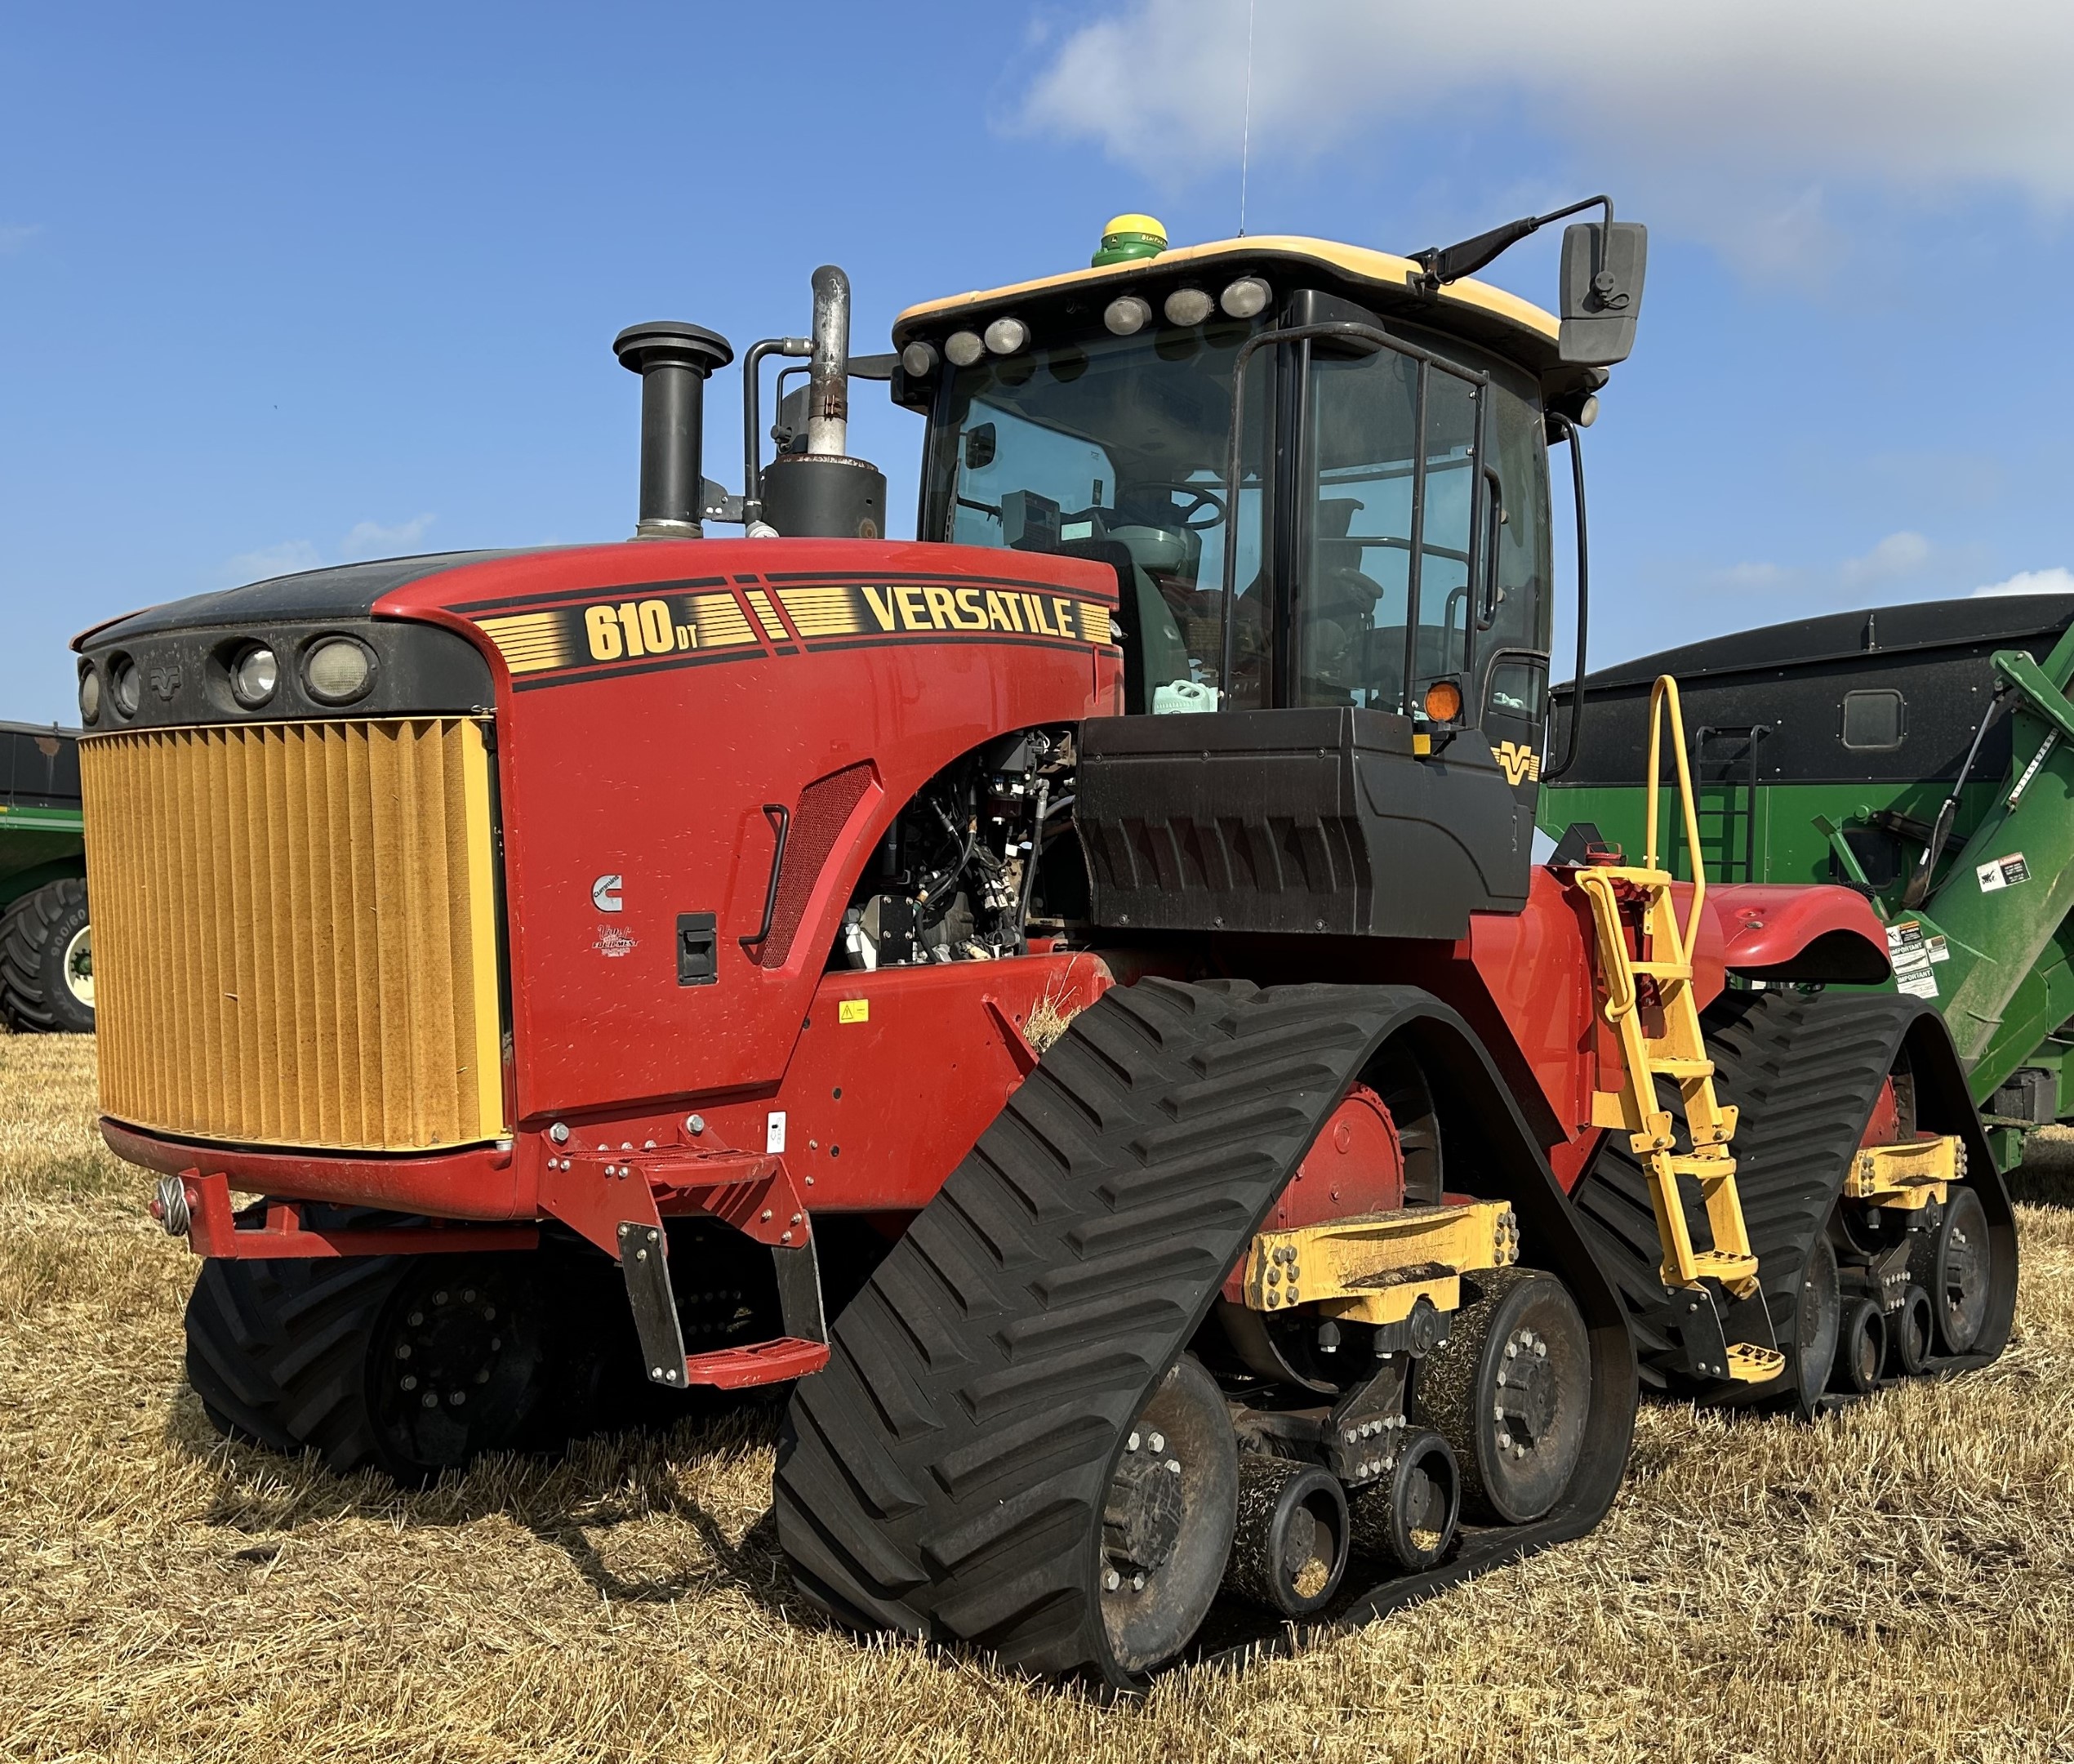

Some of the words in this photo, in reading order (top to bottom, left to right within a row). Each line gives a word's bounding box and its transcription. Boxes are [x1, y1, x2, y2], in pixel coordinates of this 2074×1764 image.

[861, 586, 1076, 639] VERSATILE
[585, 599, 674, 661] 610
[675, 624, 698, 650] DT
[594, 875, 619, 898] Cummins
[1890, 942, 1923, 956] IMPORTANT
[1897, 969, 1931, 983] IMPORTANT
